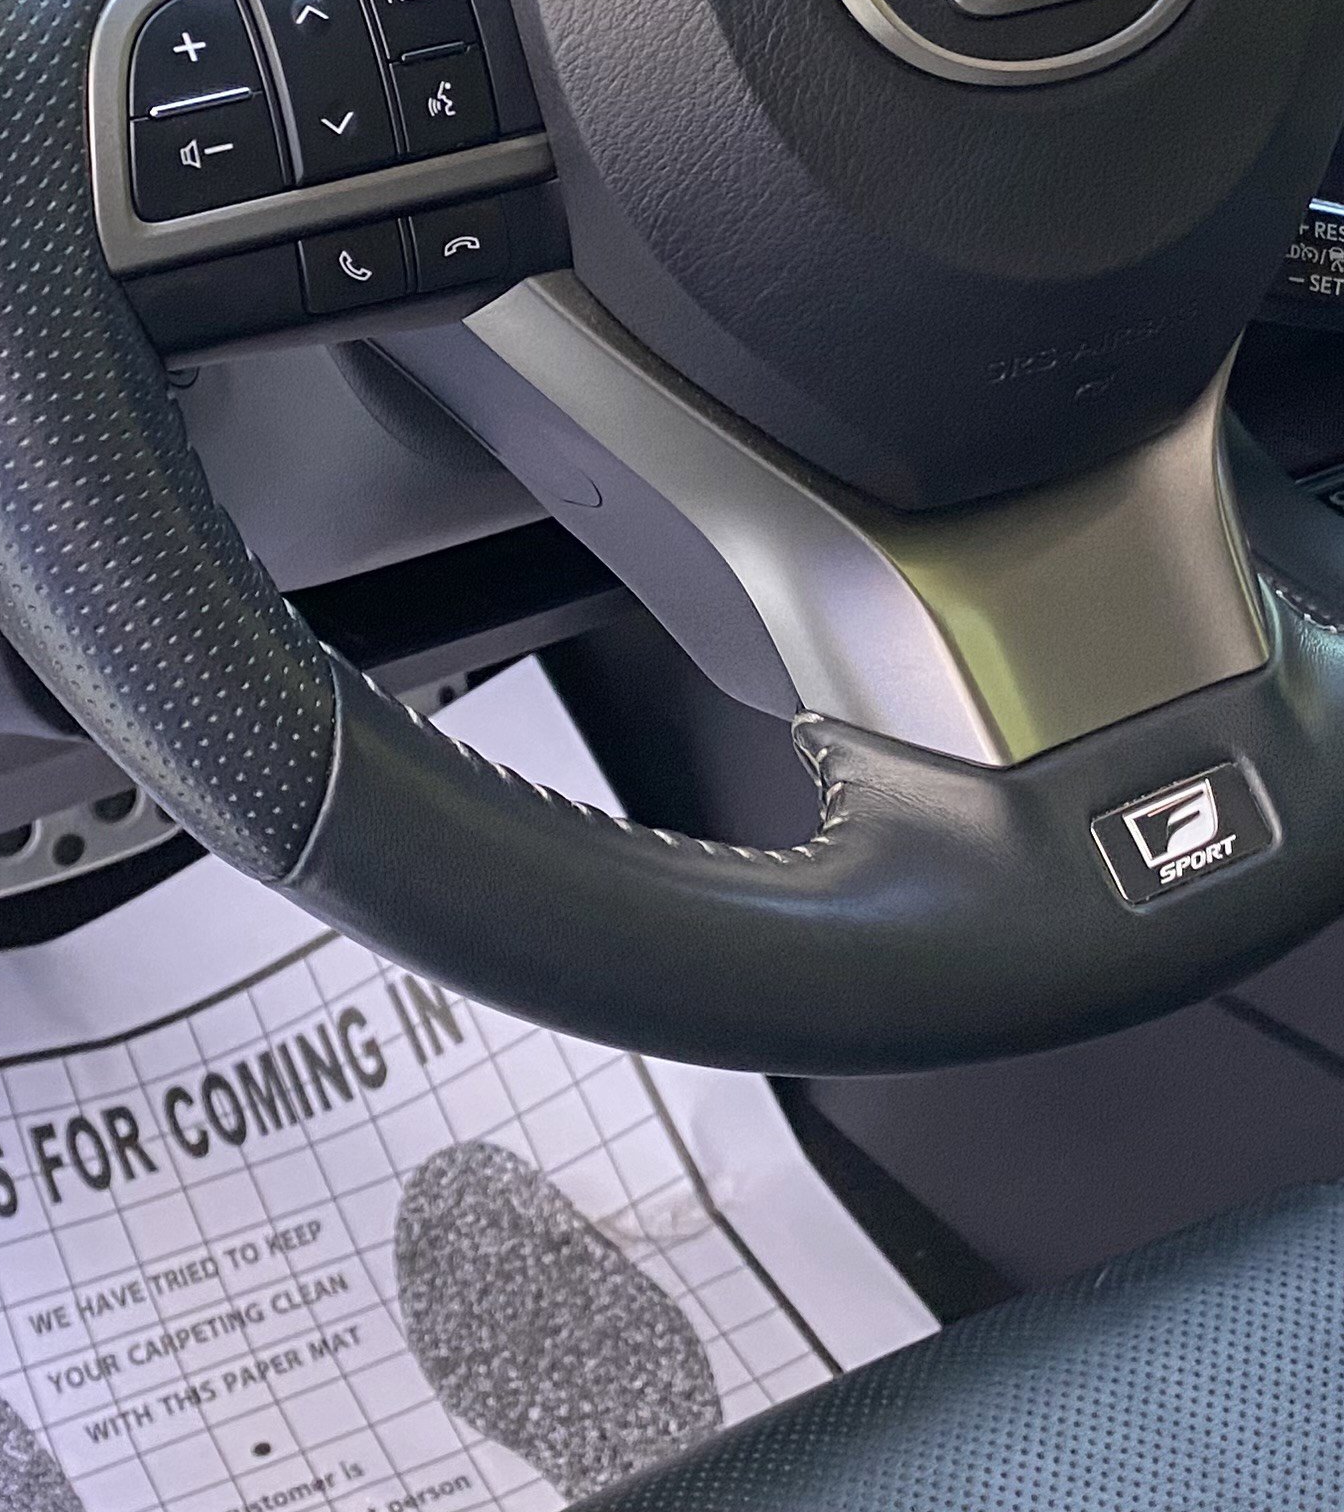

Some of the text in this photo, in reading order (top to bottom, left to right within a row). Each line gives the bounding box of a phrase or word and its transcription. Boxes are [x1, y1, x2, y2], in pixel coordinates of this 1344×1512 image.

[1159, 834, 1237, 885] SPORT
[29, 1105, 158, 1205] FOR
[164, 1006, 388, 1159] COMING
[387, 973, 464, 1067] IN
[28, 1219, 322, 1337] WE HAVE TRIED TO KEEP
[47, 1273, 350, 1395] YOUR CARPETING CLEAN
[85, 1324, 363, 1445] WITH THIS PAPER MAT
[339, 1460, 366, 1482] is
